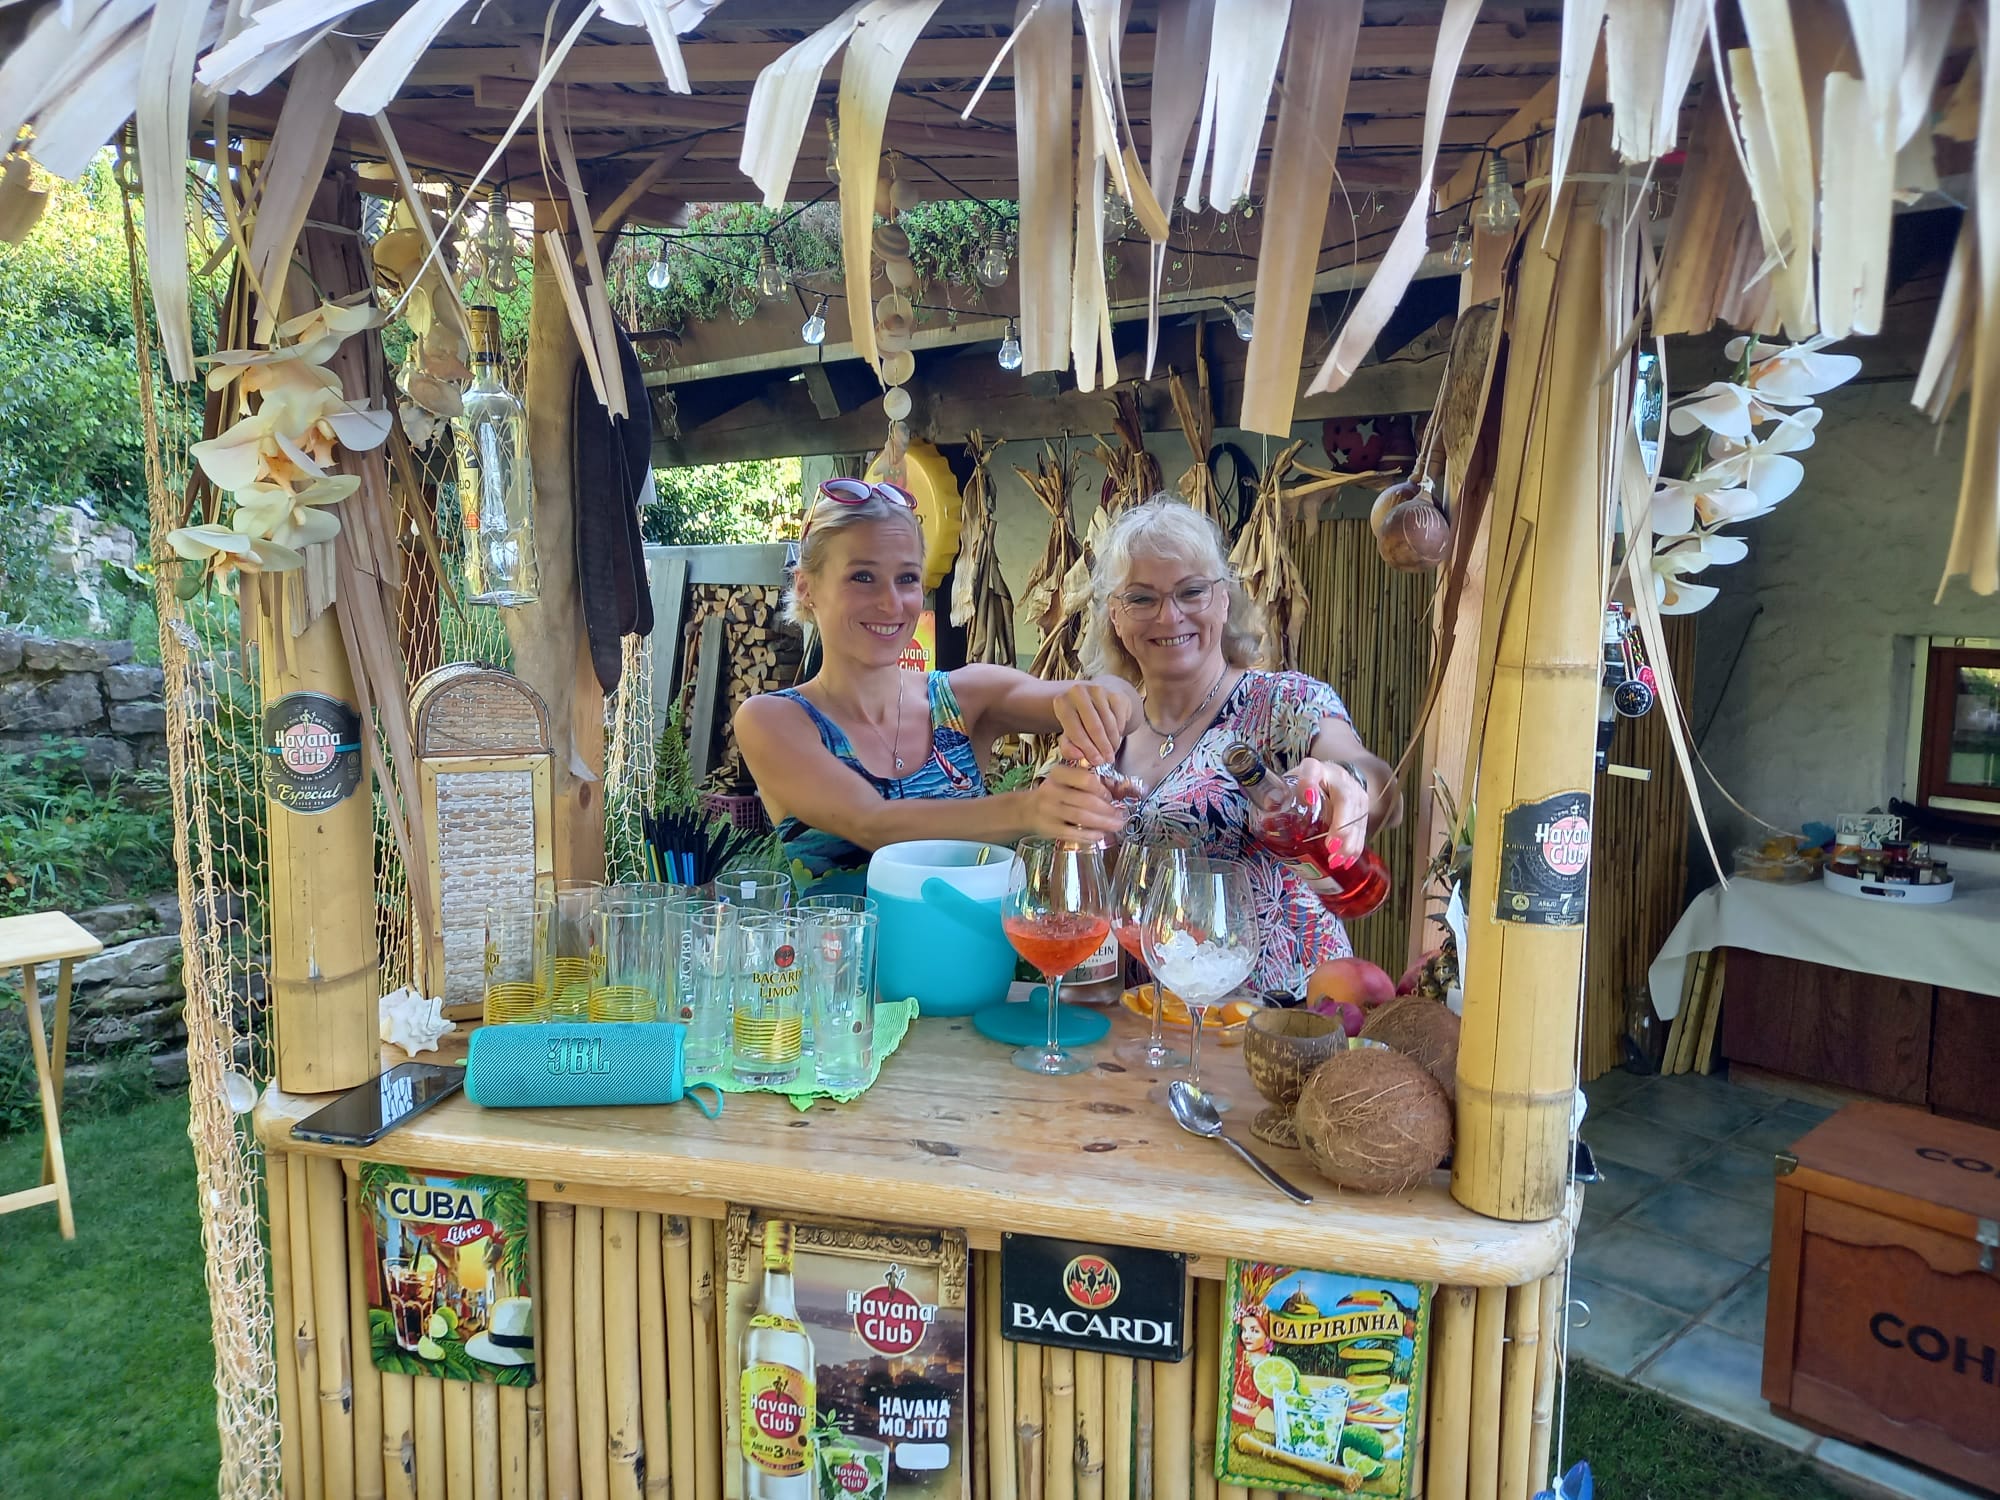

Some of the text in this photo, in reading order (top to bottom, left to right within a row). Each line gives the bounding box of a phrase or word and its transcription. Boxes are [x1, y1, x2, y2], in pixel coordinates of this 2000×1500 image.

[899, 648, 930, 660] vana
[275, 730, 341, 748] Havana
[288, 749, 328, 765] Club
[277, 782, 342, 806] Especial
[1535, 823, 1590, 844] Havan
[1549, 846, 1587, 865] Club
[1560, 893, 1573, 915] 7
[547, 1037, 611, 1076] JBL
[1915, 1147, 2000, 1179] CO
[390, 1187, 476, 1221] CUBA
[441, 1223, 483, 1245] Libre
[846, 1290, 938, 1324] Havana
[864, 1318, 913, 1345] Club
[1012, 1302, 1176, 1347] BACARDI
[1272, 1313, 1400, 1341] CAIPIRINHA
[1869, 1312, 2000, 1387] COH
[750, 1393, 807, 1418] Havana
[878, 1396, 951, 1420] HAVANA
[759, 1412, 795, 1433] Club
[878, 1416, 948, 1439] MOJITO
[773, 1445, 784, 1458] 3
[841, 1478, 864, 1489] Club
